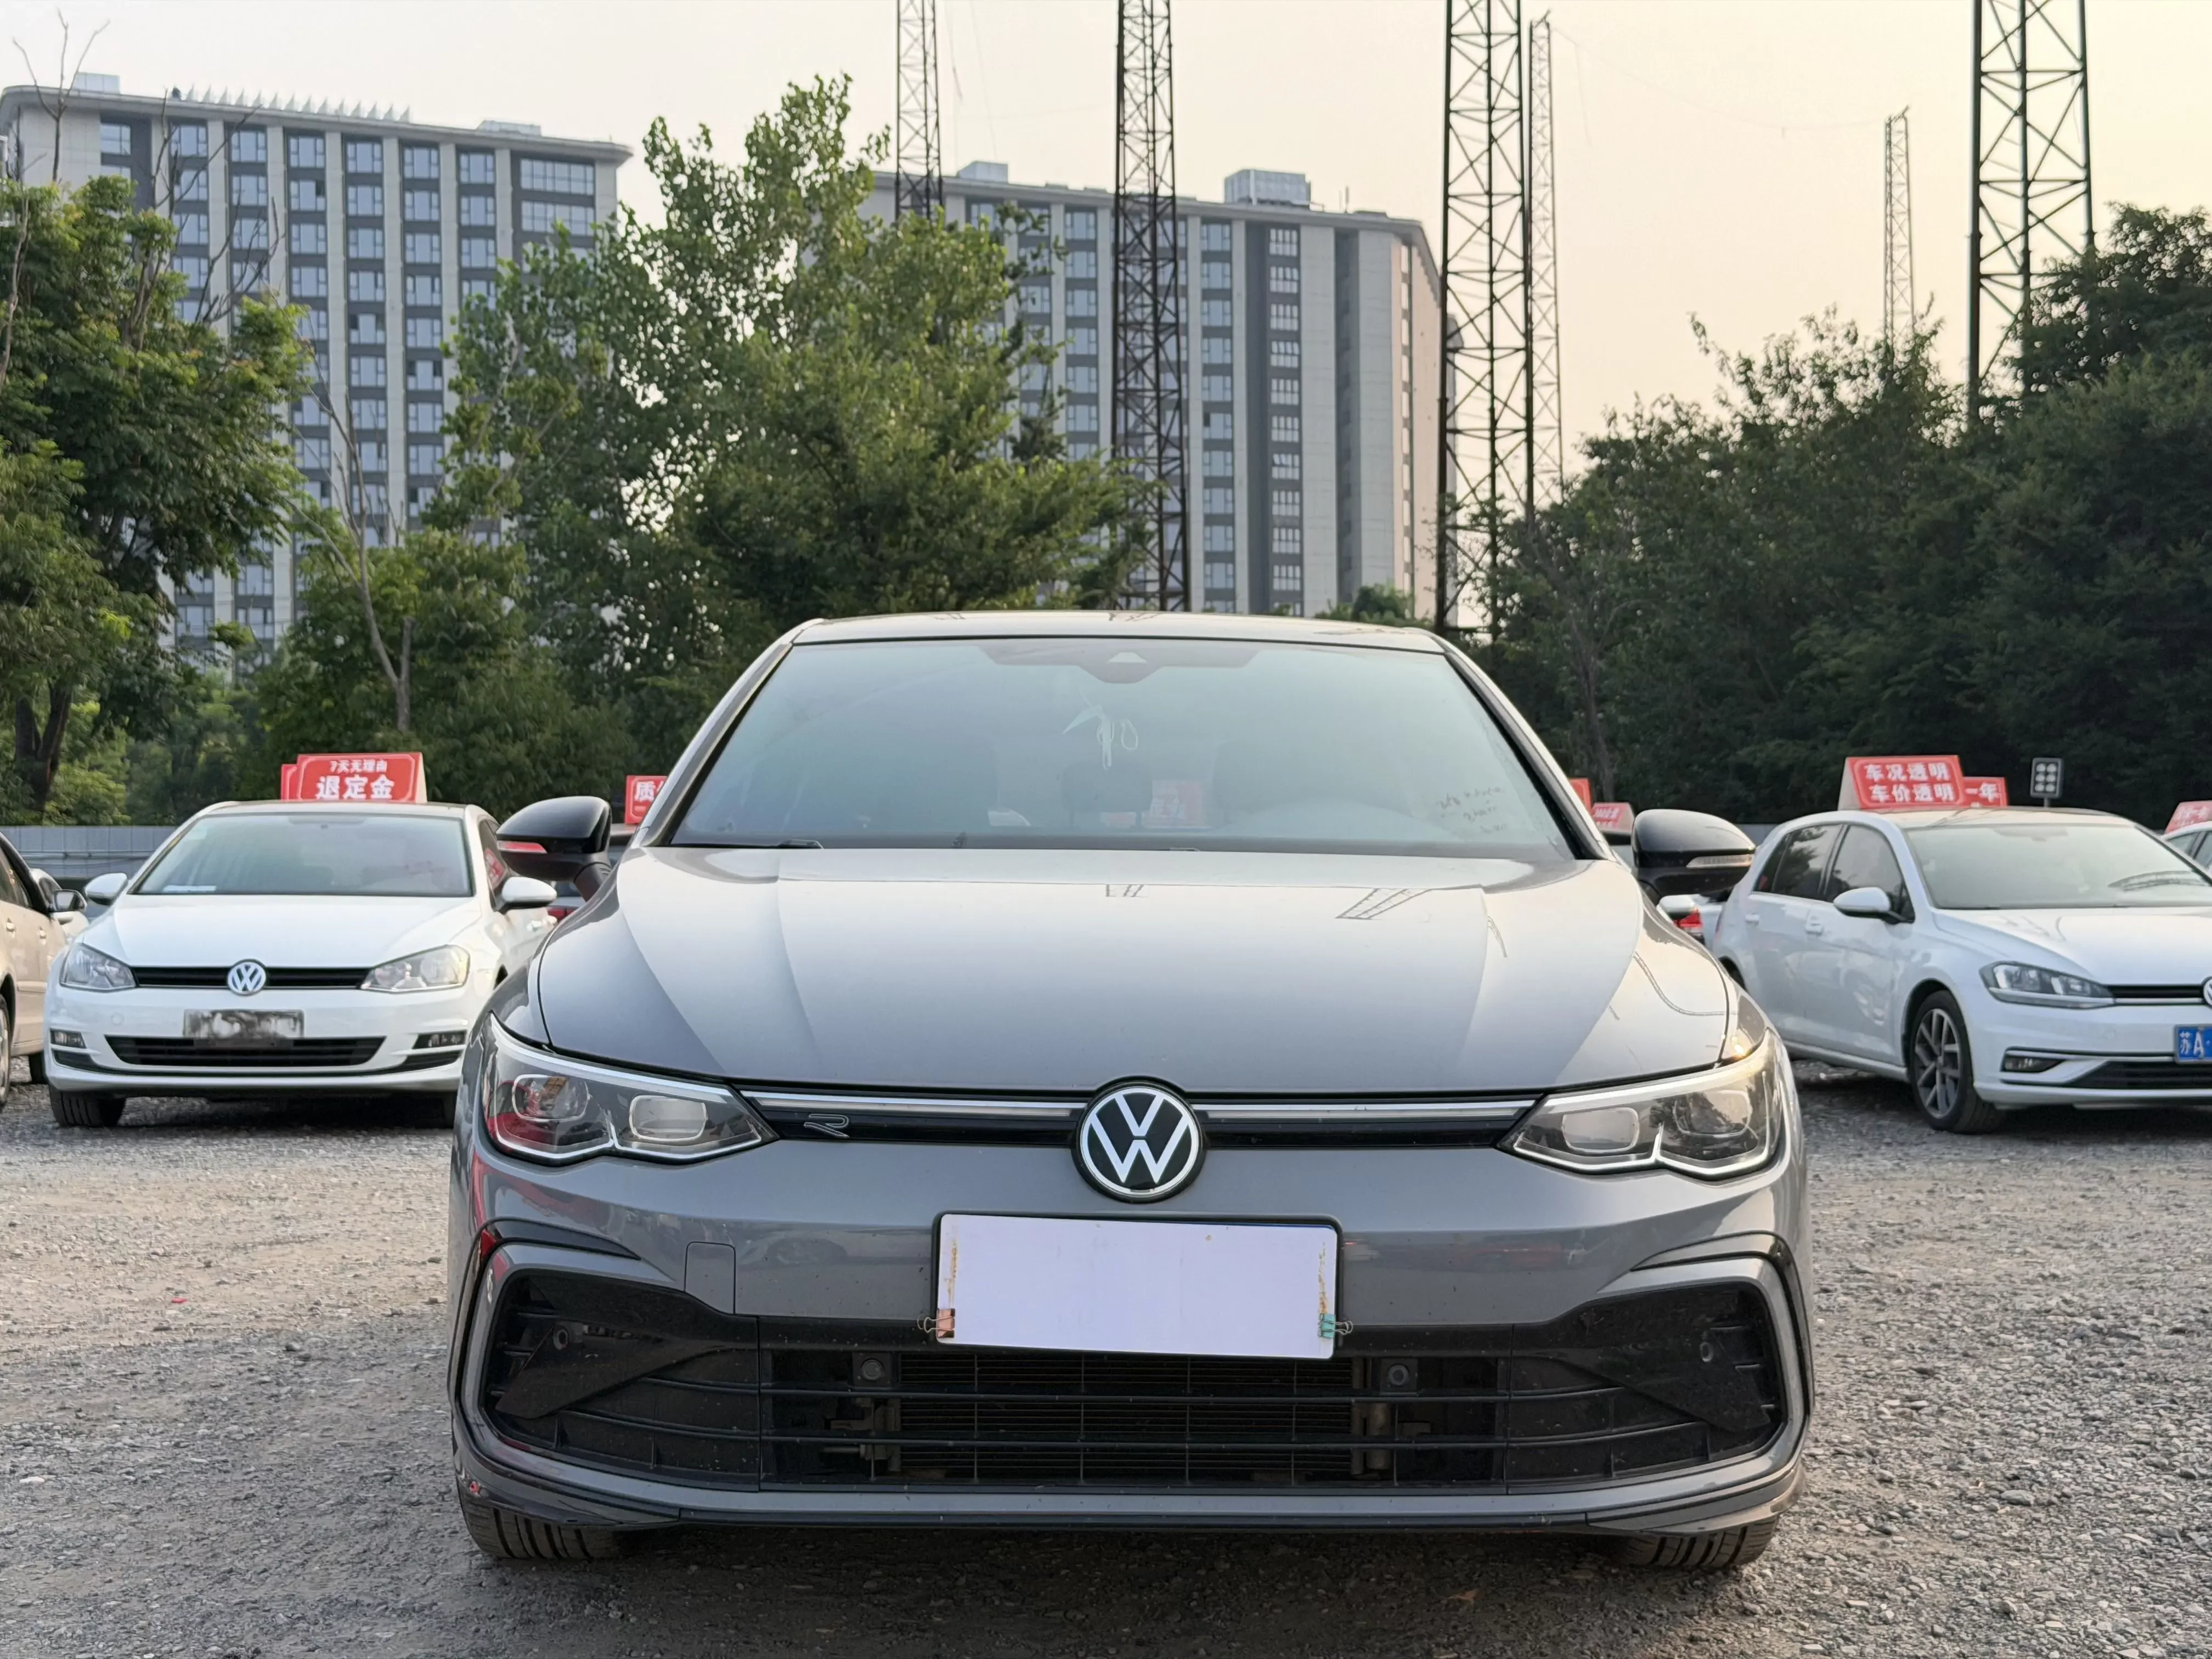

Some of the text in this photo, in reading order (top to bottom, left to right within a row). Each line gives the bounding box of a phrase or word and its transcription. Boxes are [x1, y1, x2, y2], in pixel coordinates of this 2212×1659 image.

[1864, 761, 1950, 782] 车况透明
[315, 774, 395, 799] 退定金
[1869, 782, 1955, 803] 车价透明
[803, 1113, 850, 1139] R
[1085, 1088, 1194, 1188] VW
